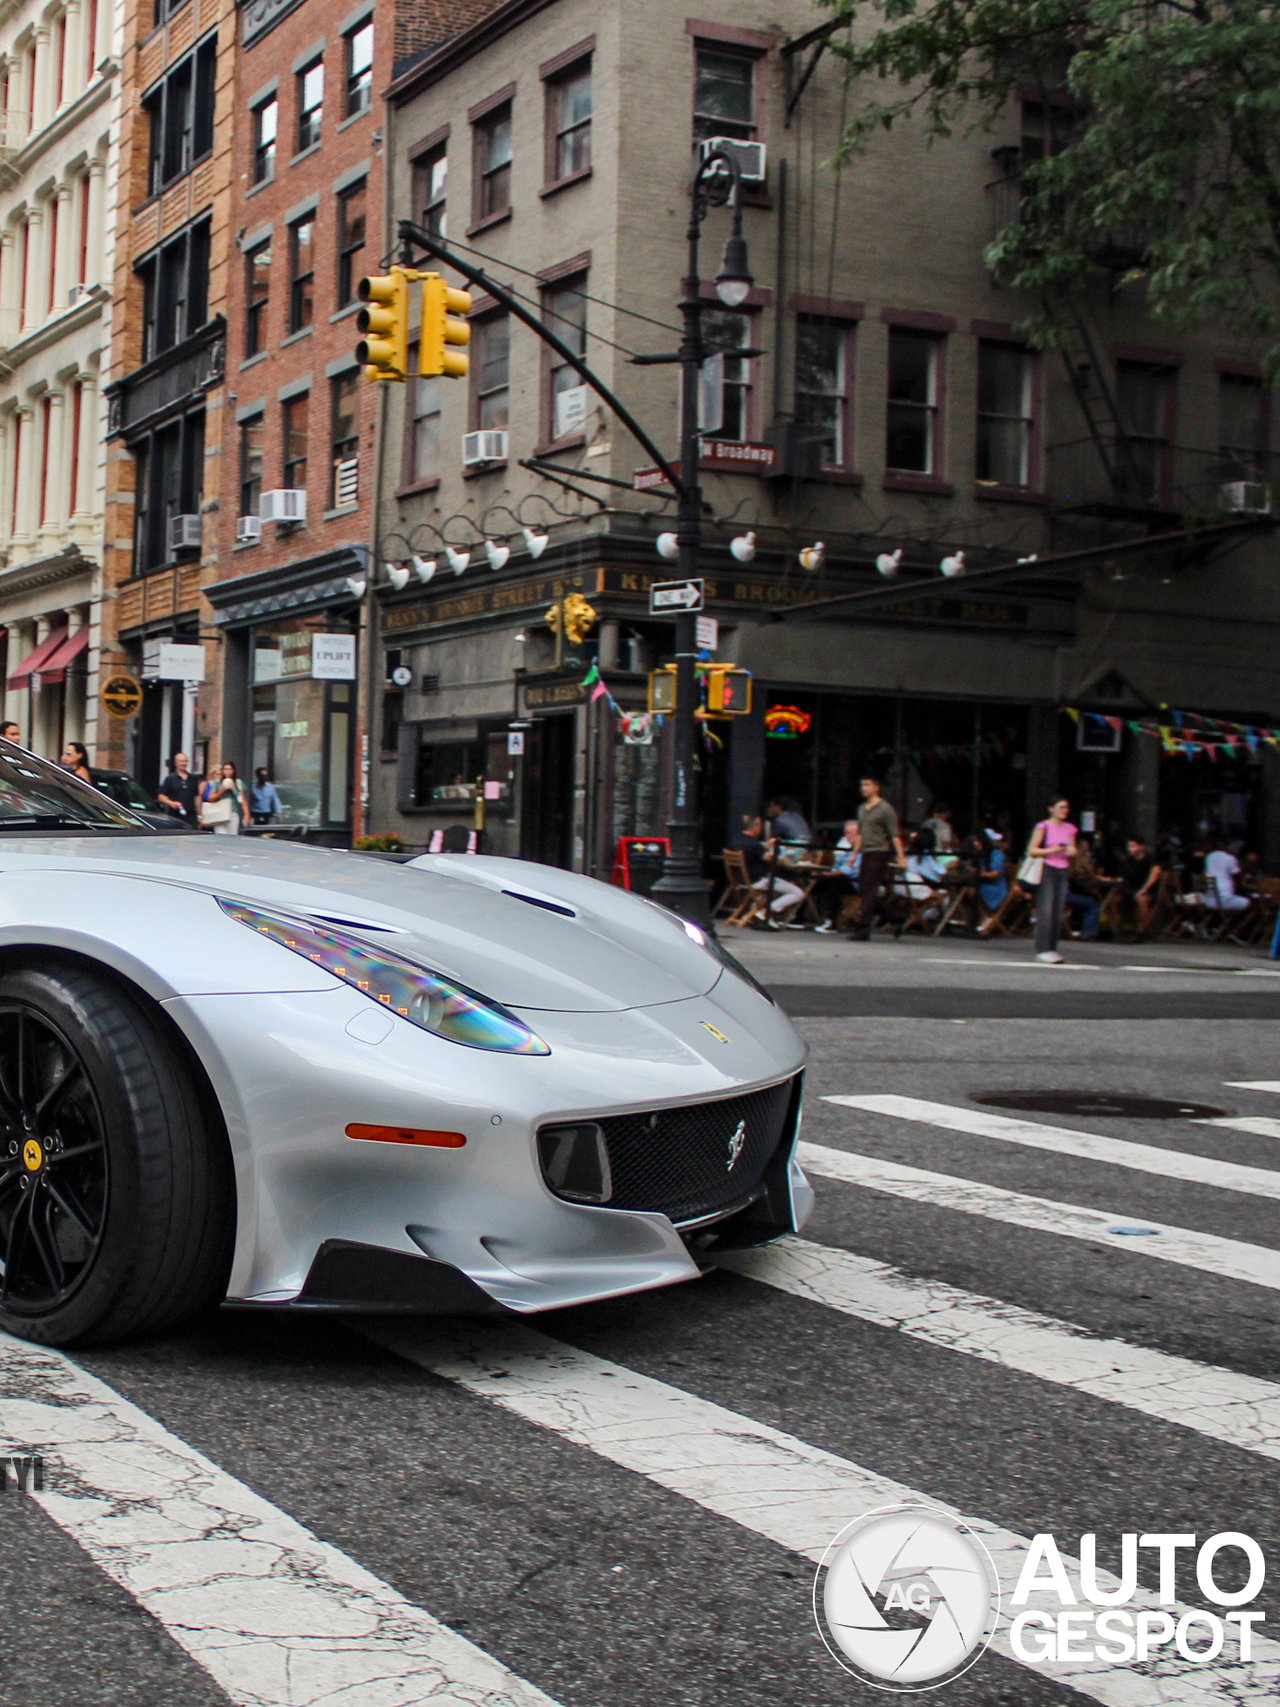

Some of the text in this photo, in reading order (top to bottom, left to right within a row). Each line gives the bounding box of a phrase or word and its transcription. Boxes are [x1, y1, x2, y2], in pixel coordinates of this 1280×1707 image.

[702, 442, 774, 464] W Broadway
[493, 583, 545, 608] STREET
[316, 651, 352, 661] UPLIFT
[511, 735, 520, 747] A
